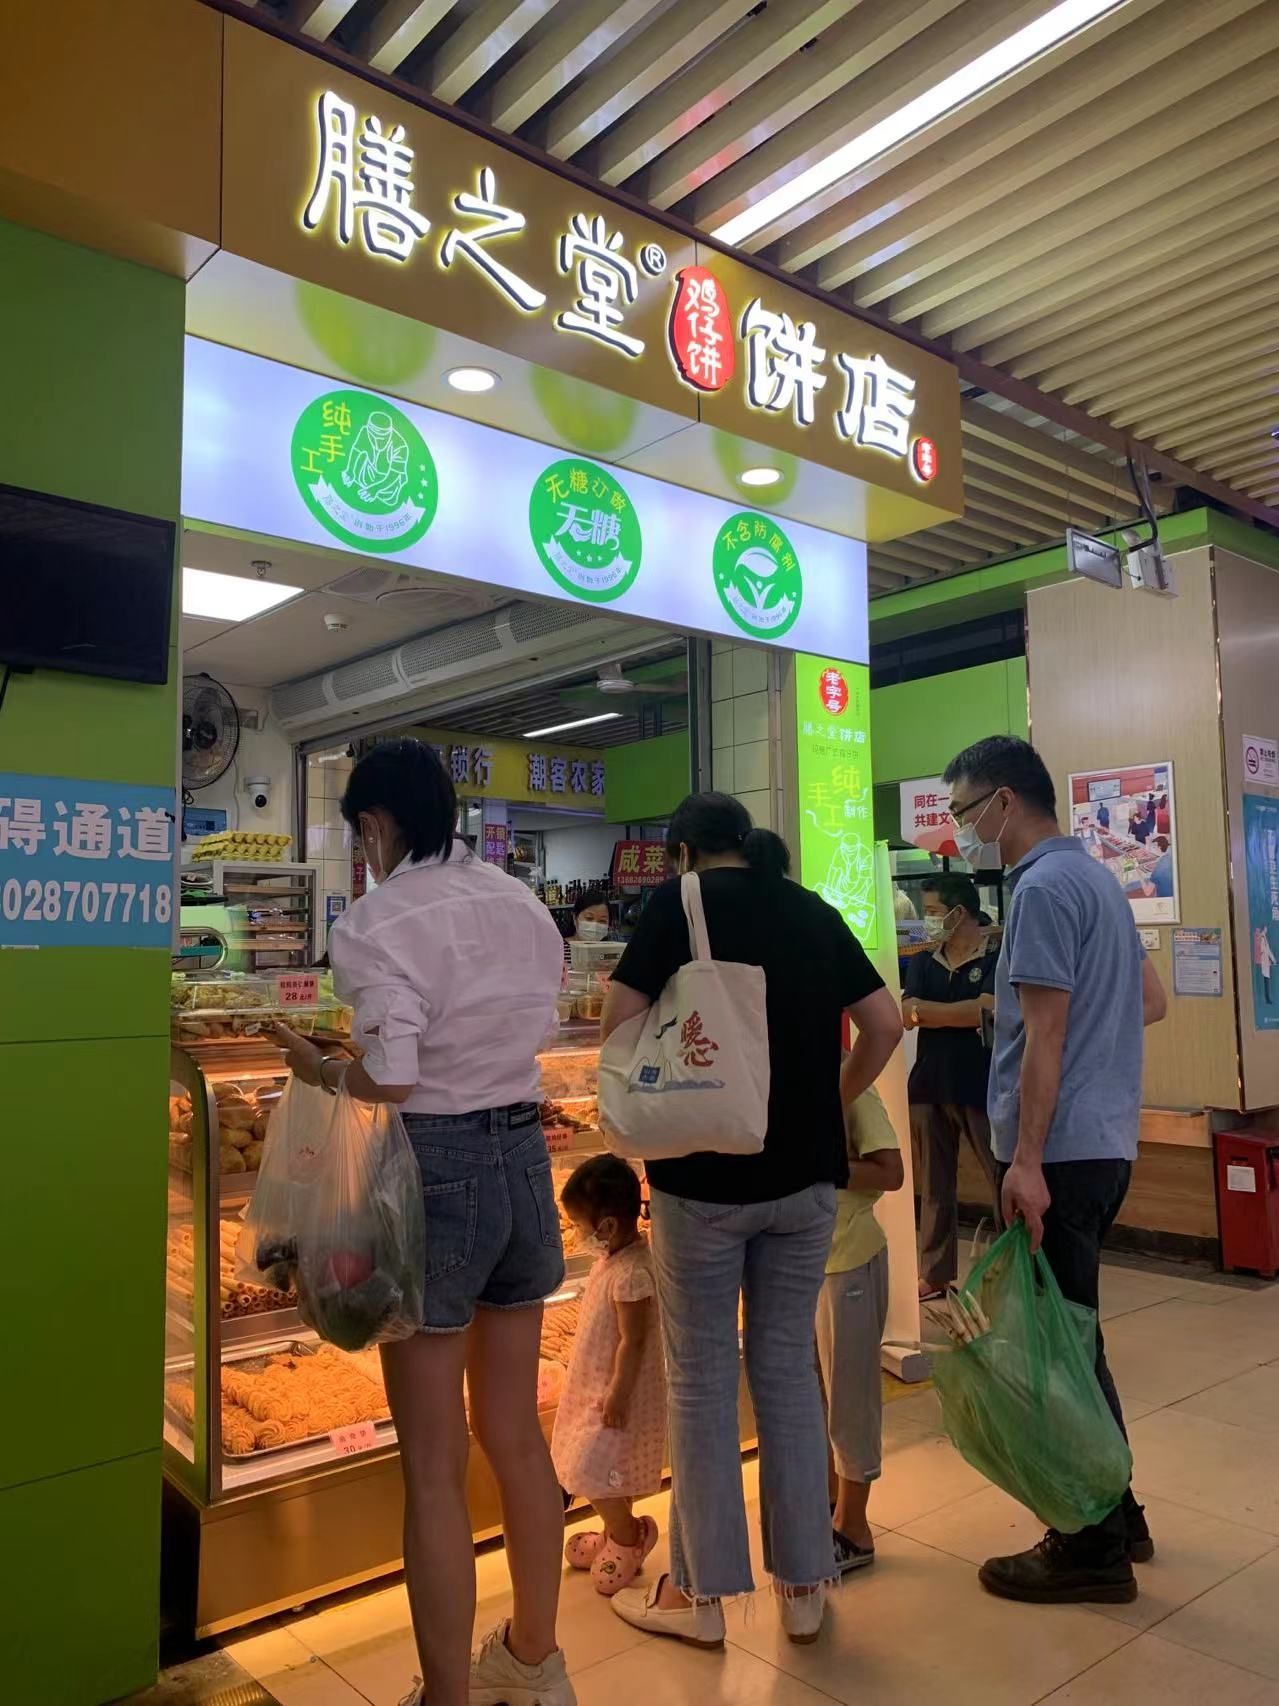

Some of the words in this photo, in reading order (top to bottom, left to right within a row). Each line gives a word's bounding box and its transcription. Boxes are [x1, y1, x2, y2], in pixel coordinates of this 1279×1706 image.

[302, 90, 646, 357] 膳之堂
[685, 277, 723, 388] 鸡仔饼
[740, 298, 918, 458] 饼店
[437, 746, 495, 786] 锁行
[0, 797, 173, 861] 碍通道
[914, 811, 951, 828] 共建文
[617, 844, 666, 873] 咸菜
[3, 878, 171, 923] 028707718
